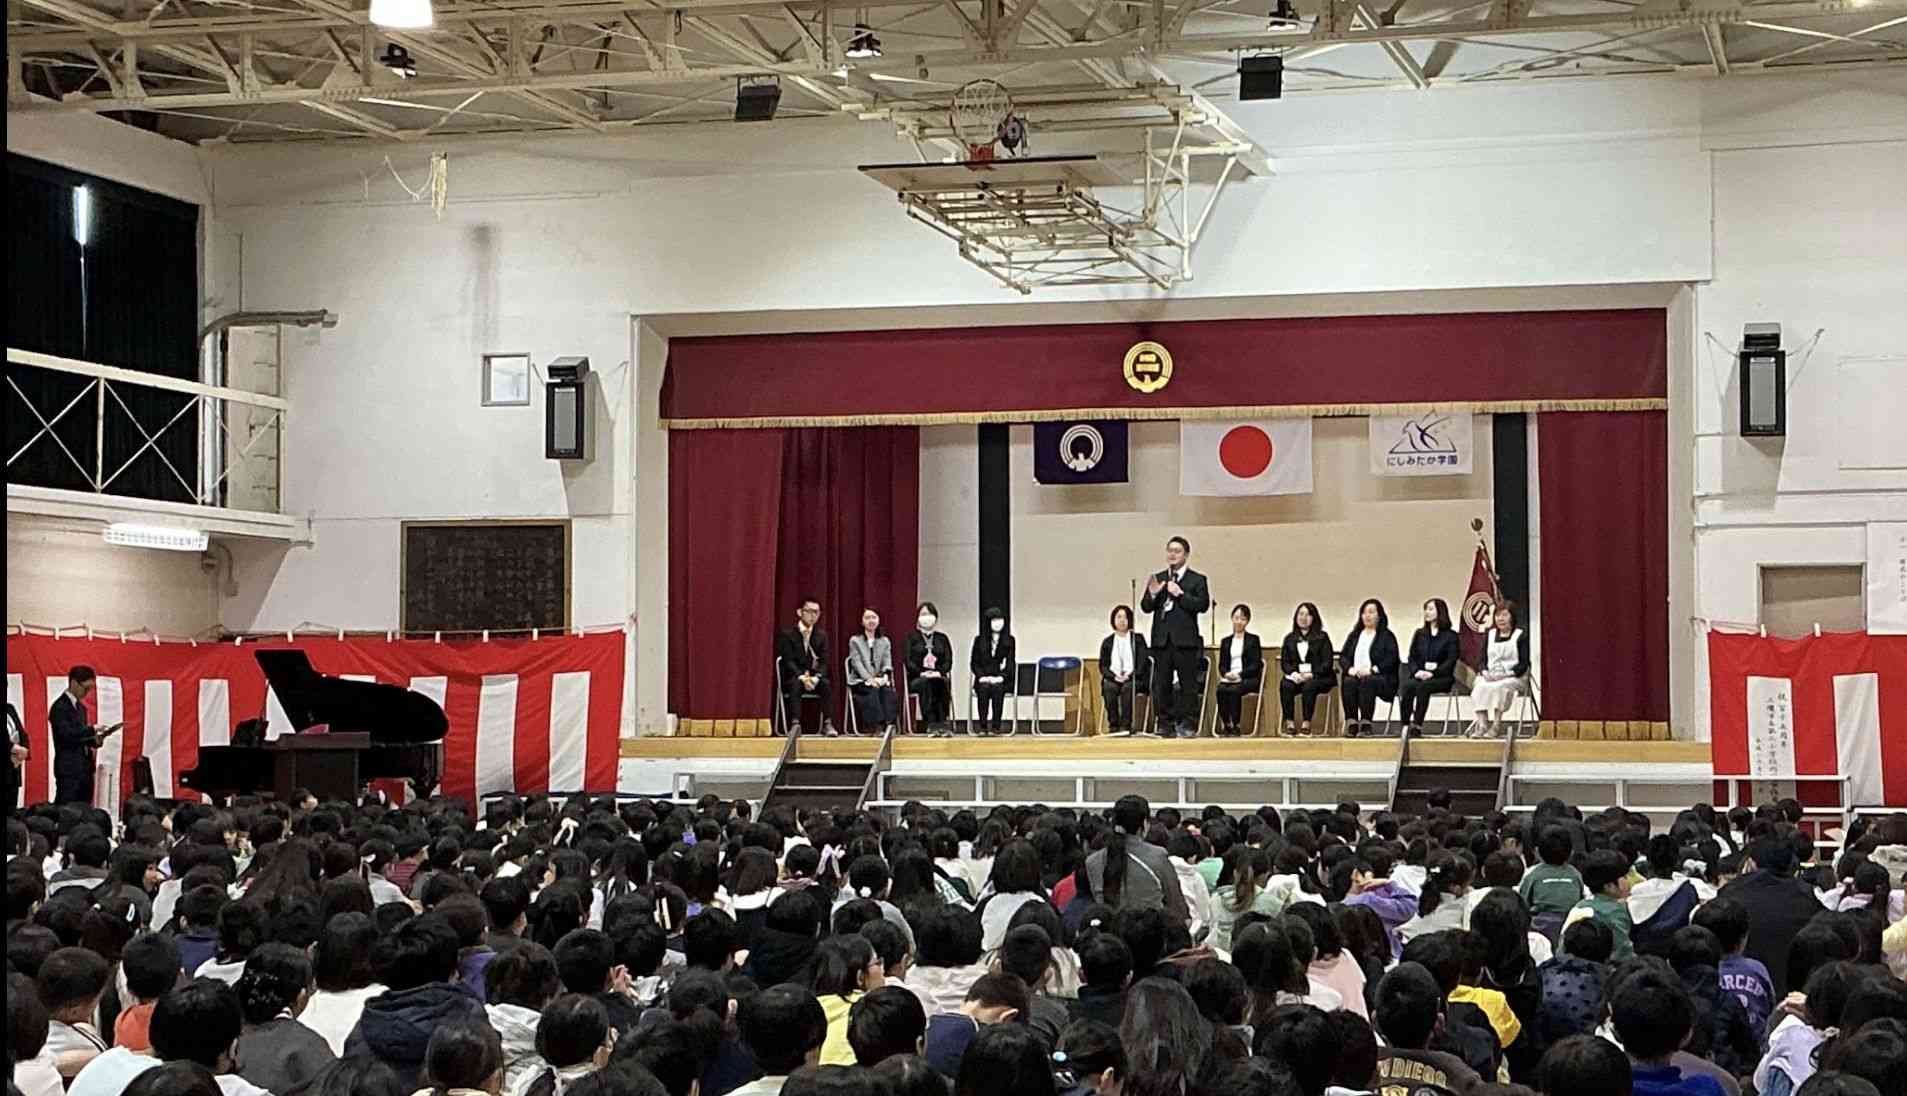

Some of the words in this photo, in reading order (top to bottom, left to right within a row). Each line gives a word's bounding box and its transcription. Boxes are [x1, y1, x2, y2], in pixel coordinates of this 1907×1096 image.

[1386, 454, 1458, 467] にしみたか学園
